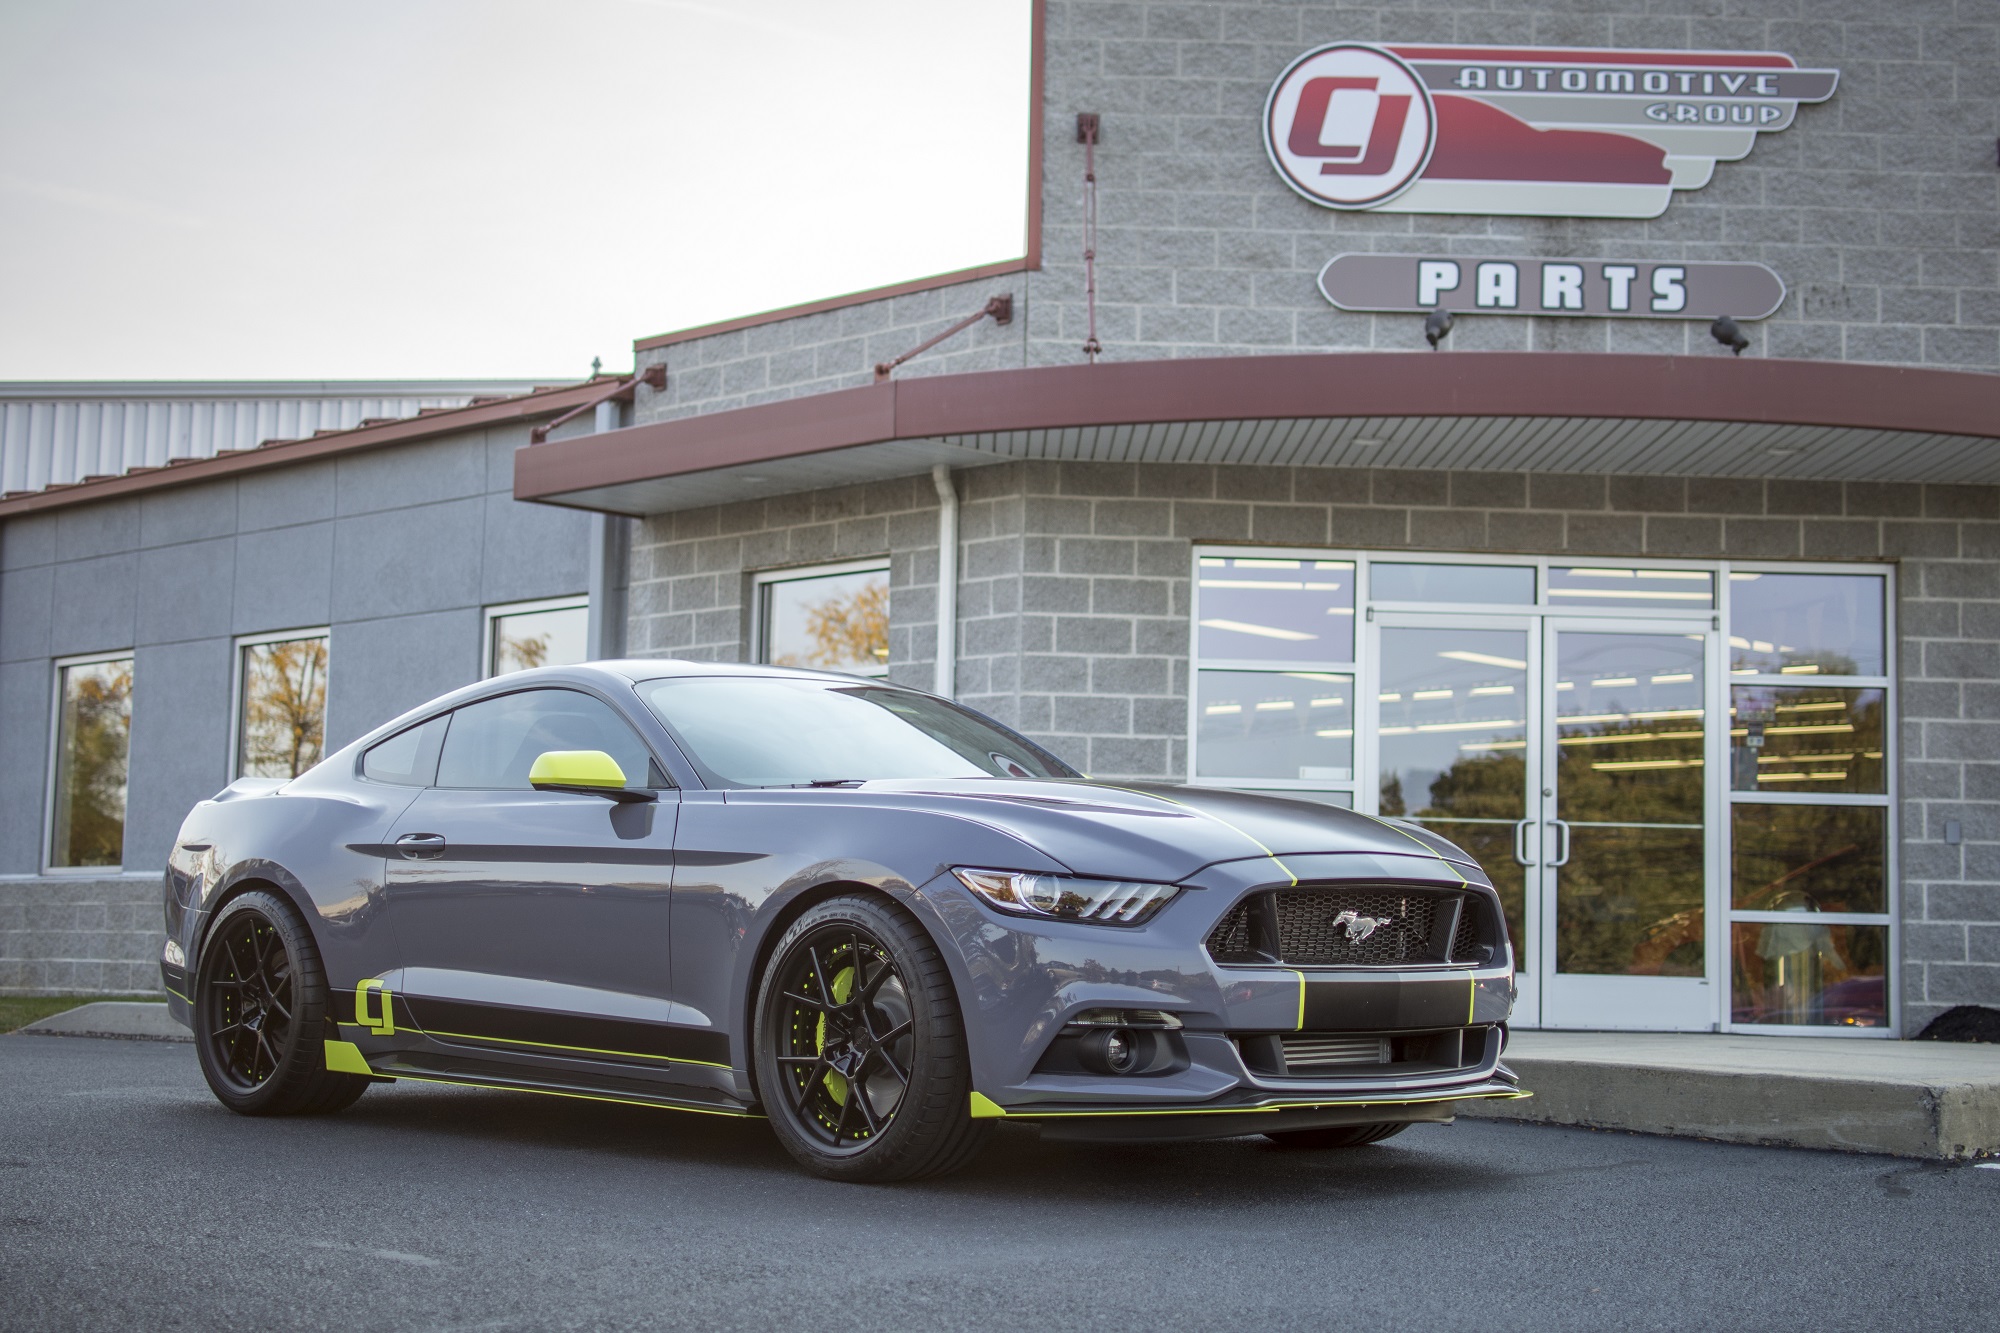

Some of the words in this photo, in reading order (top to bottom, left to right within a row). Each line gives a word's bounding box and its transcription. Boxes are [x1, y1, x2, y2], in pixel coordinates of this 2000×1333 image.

[1453, 66, 1781, 97] AUTOMOTIVE
[1643, 102, 1782, 126] GROUP
[1417, 259, 1688, 313] PARTS
